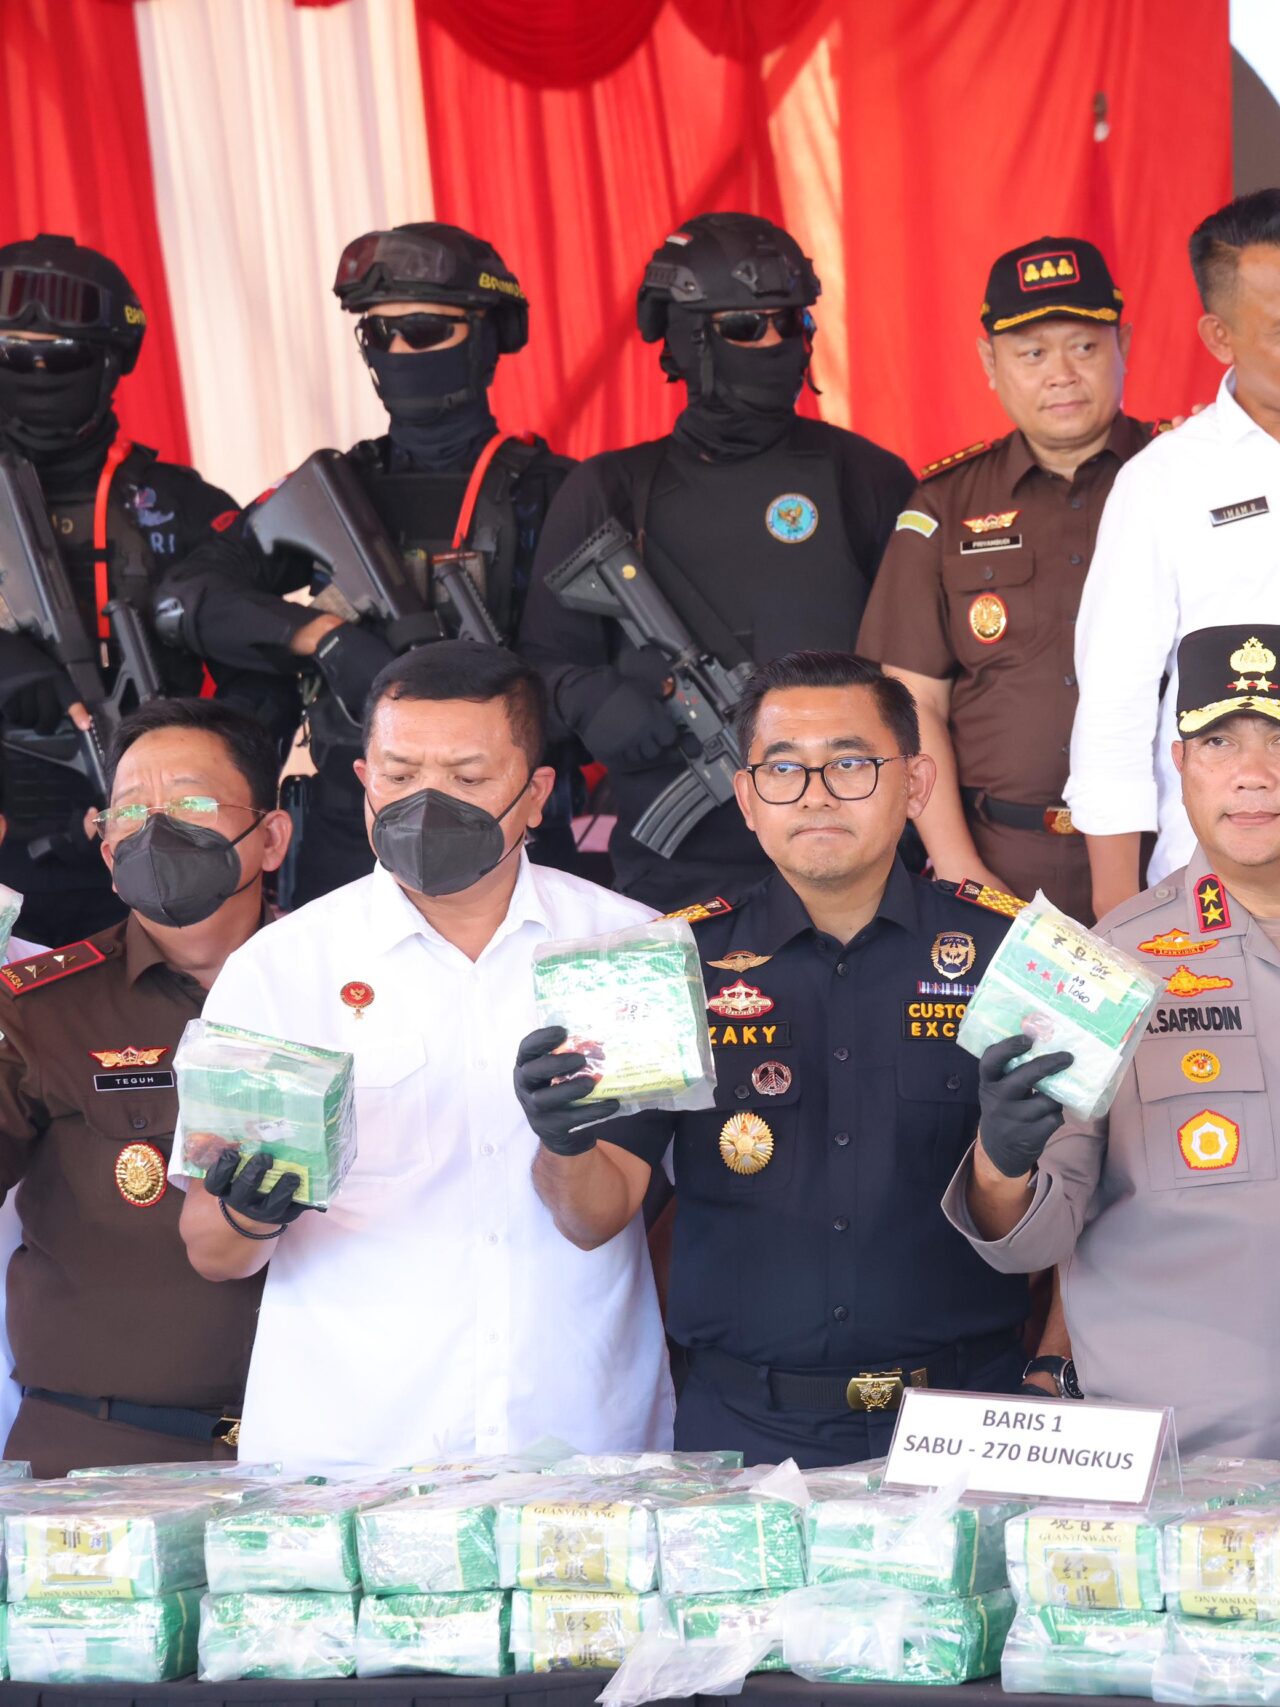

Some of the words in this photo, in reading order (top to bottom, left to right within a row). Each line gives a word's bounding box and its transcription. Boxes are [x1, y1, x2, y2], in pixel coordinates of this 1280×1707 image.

[708, 1025, 777, 1046] ZAKY
[115, 1076, 154, 1085] TEGUH
[983, 1409, 1045, 1431] BARIS
[1051, 1415, 1063, 1433] 1
[904, 1434, 963, 1456] SABU
[981, 1442, 1021, 1461] 270
[1027, 1446, 1134, 1470] BUNGKUS
